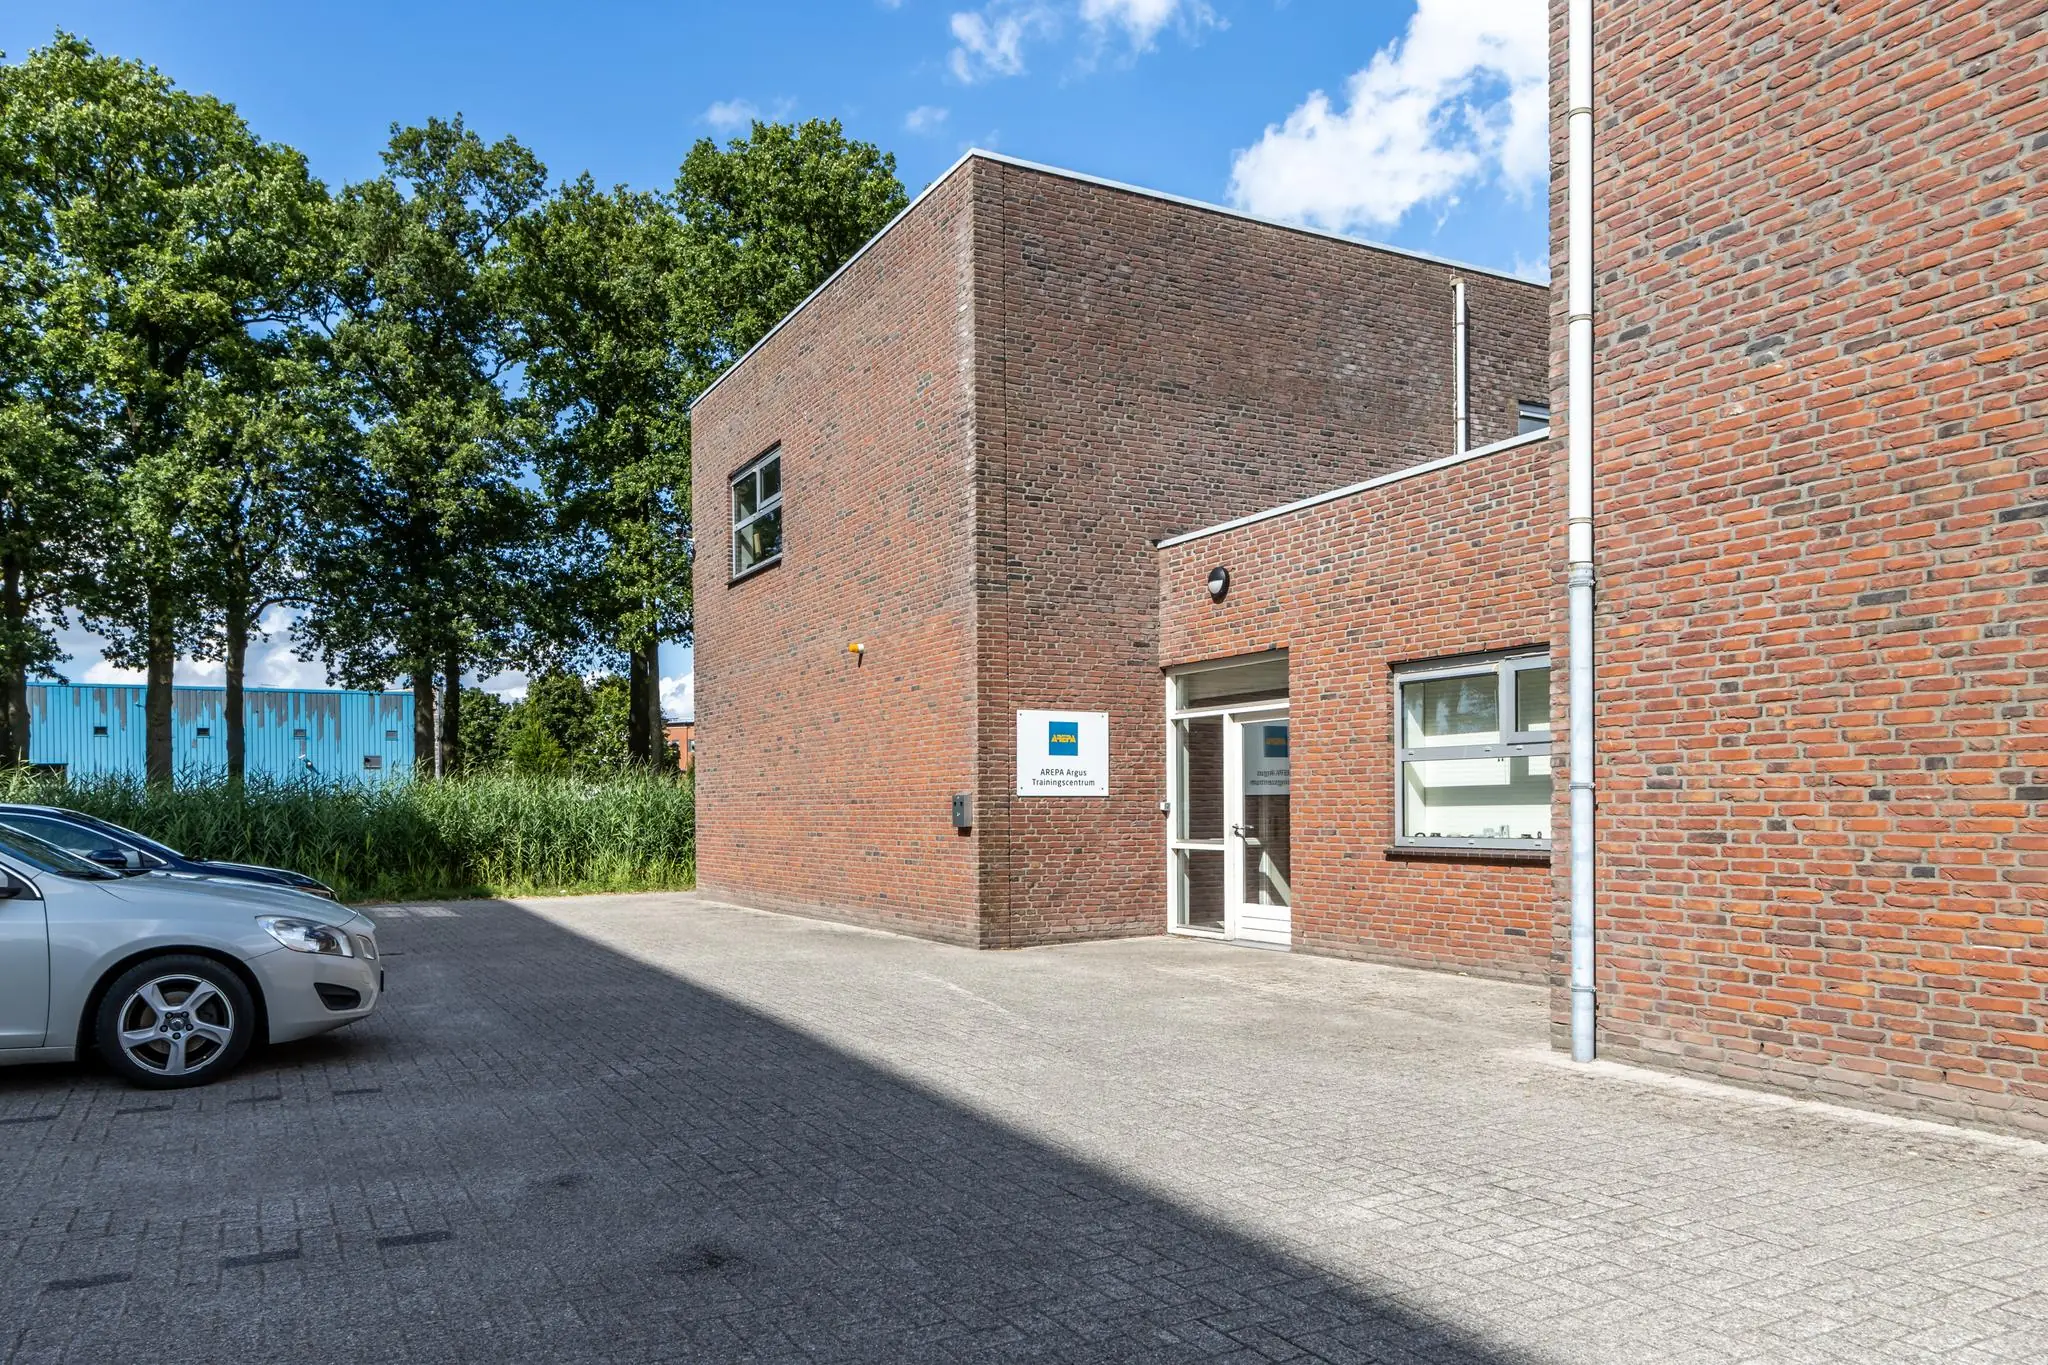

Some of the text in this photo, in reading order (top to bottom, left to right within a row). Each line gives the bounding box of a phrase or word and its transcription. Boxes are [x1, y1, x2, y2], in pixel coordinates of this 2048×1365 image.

[1051, 734, 1076, 743] AREPA
[1040, 768, 1087, 777] AREPA Argus
[1032, 778, 1095, 787] Trainingscentrum
